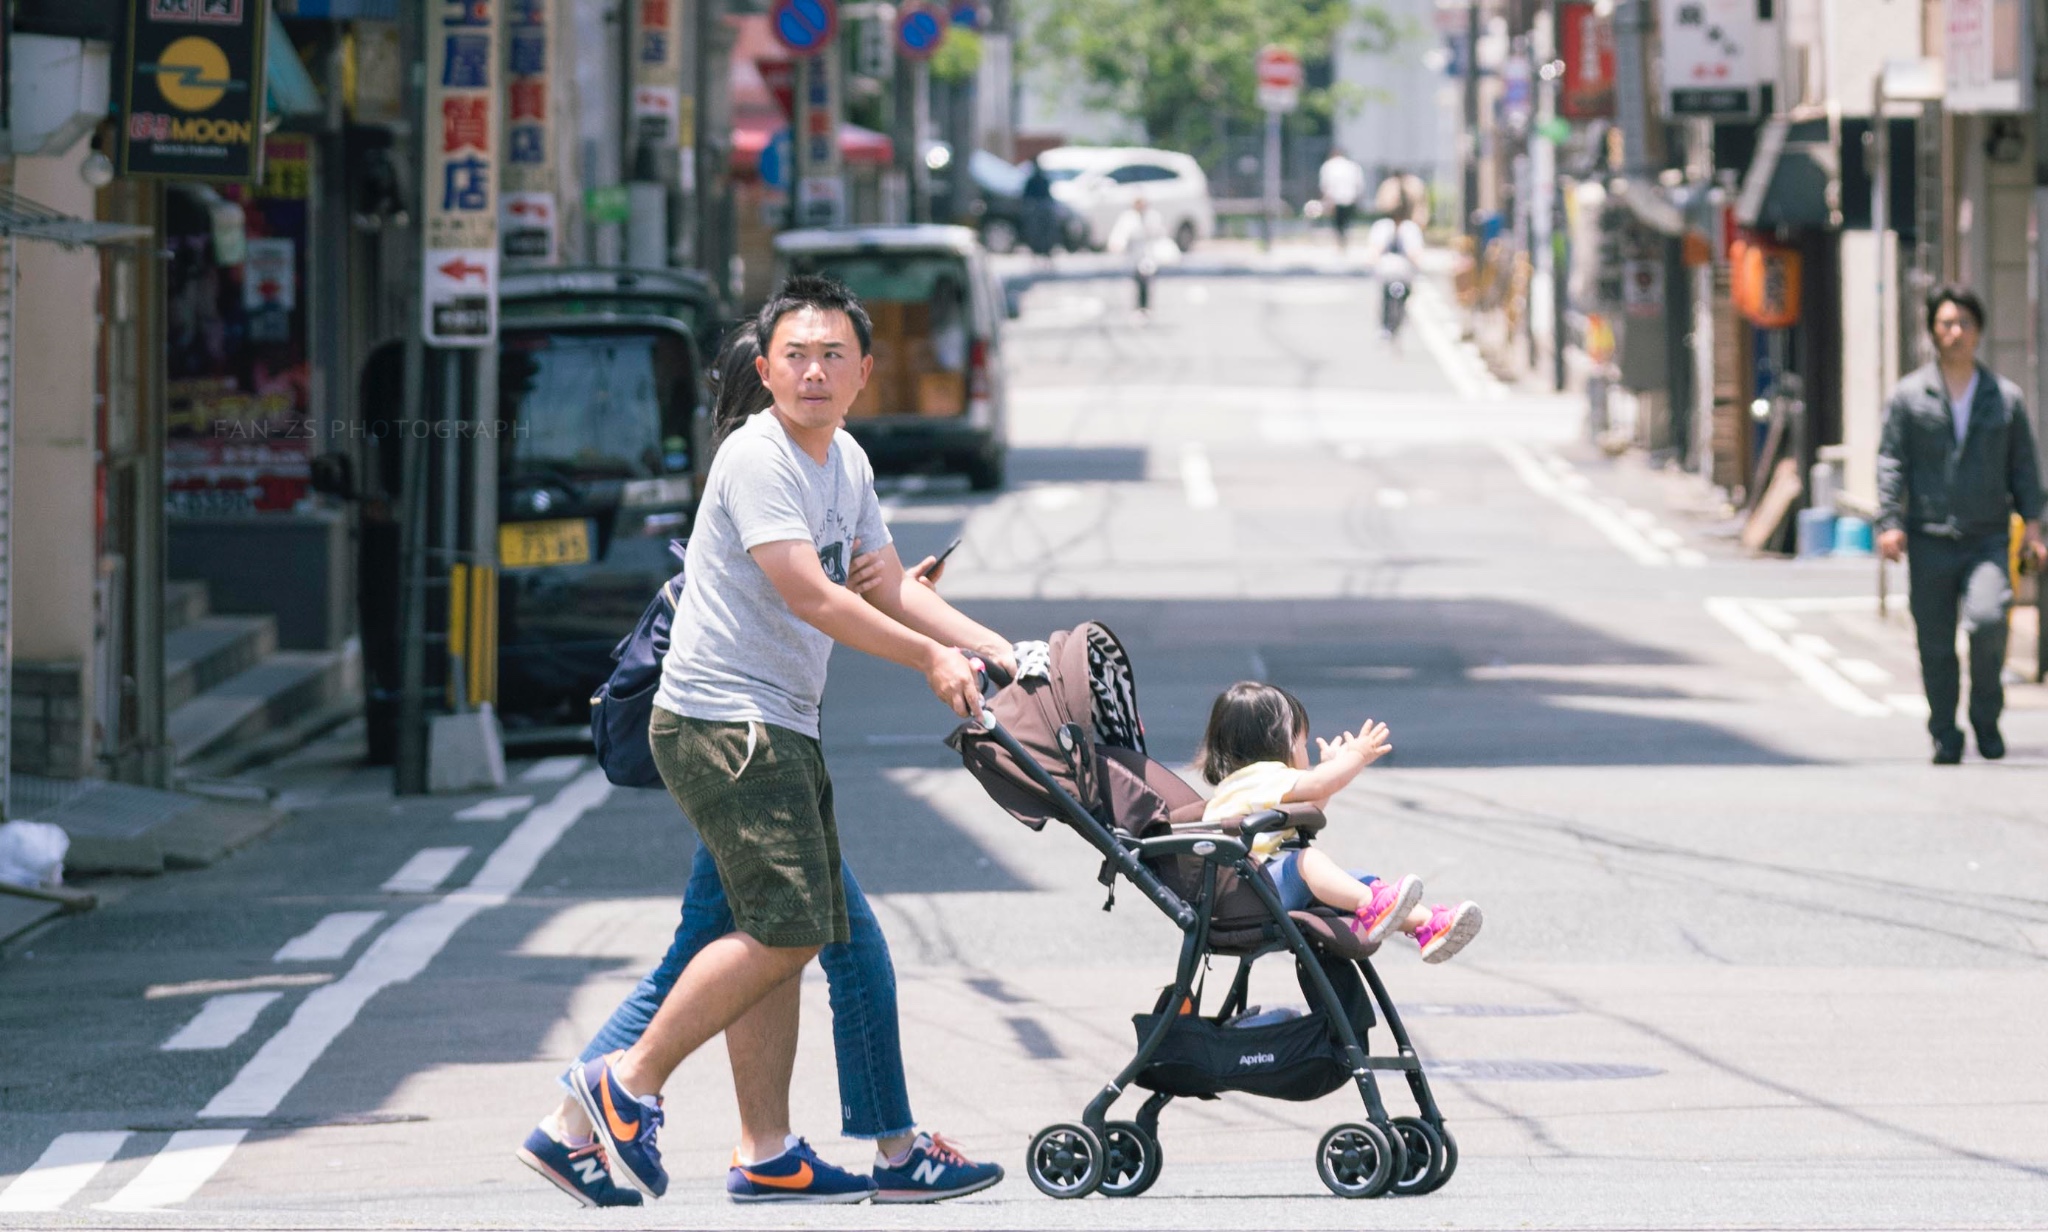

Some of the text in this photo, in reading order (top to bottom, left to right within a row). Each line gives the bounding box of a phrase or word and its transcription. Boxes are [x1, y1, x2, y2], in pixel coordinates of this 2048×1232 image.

[171, 117, 250, 145] MOON
[1239, 1051, 1275, 1066] Aprica
[571, 1157, 607, 1184] N
[911, 1158, 946, 1185] N
